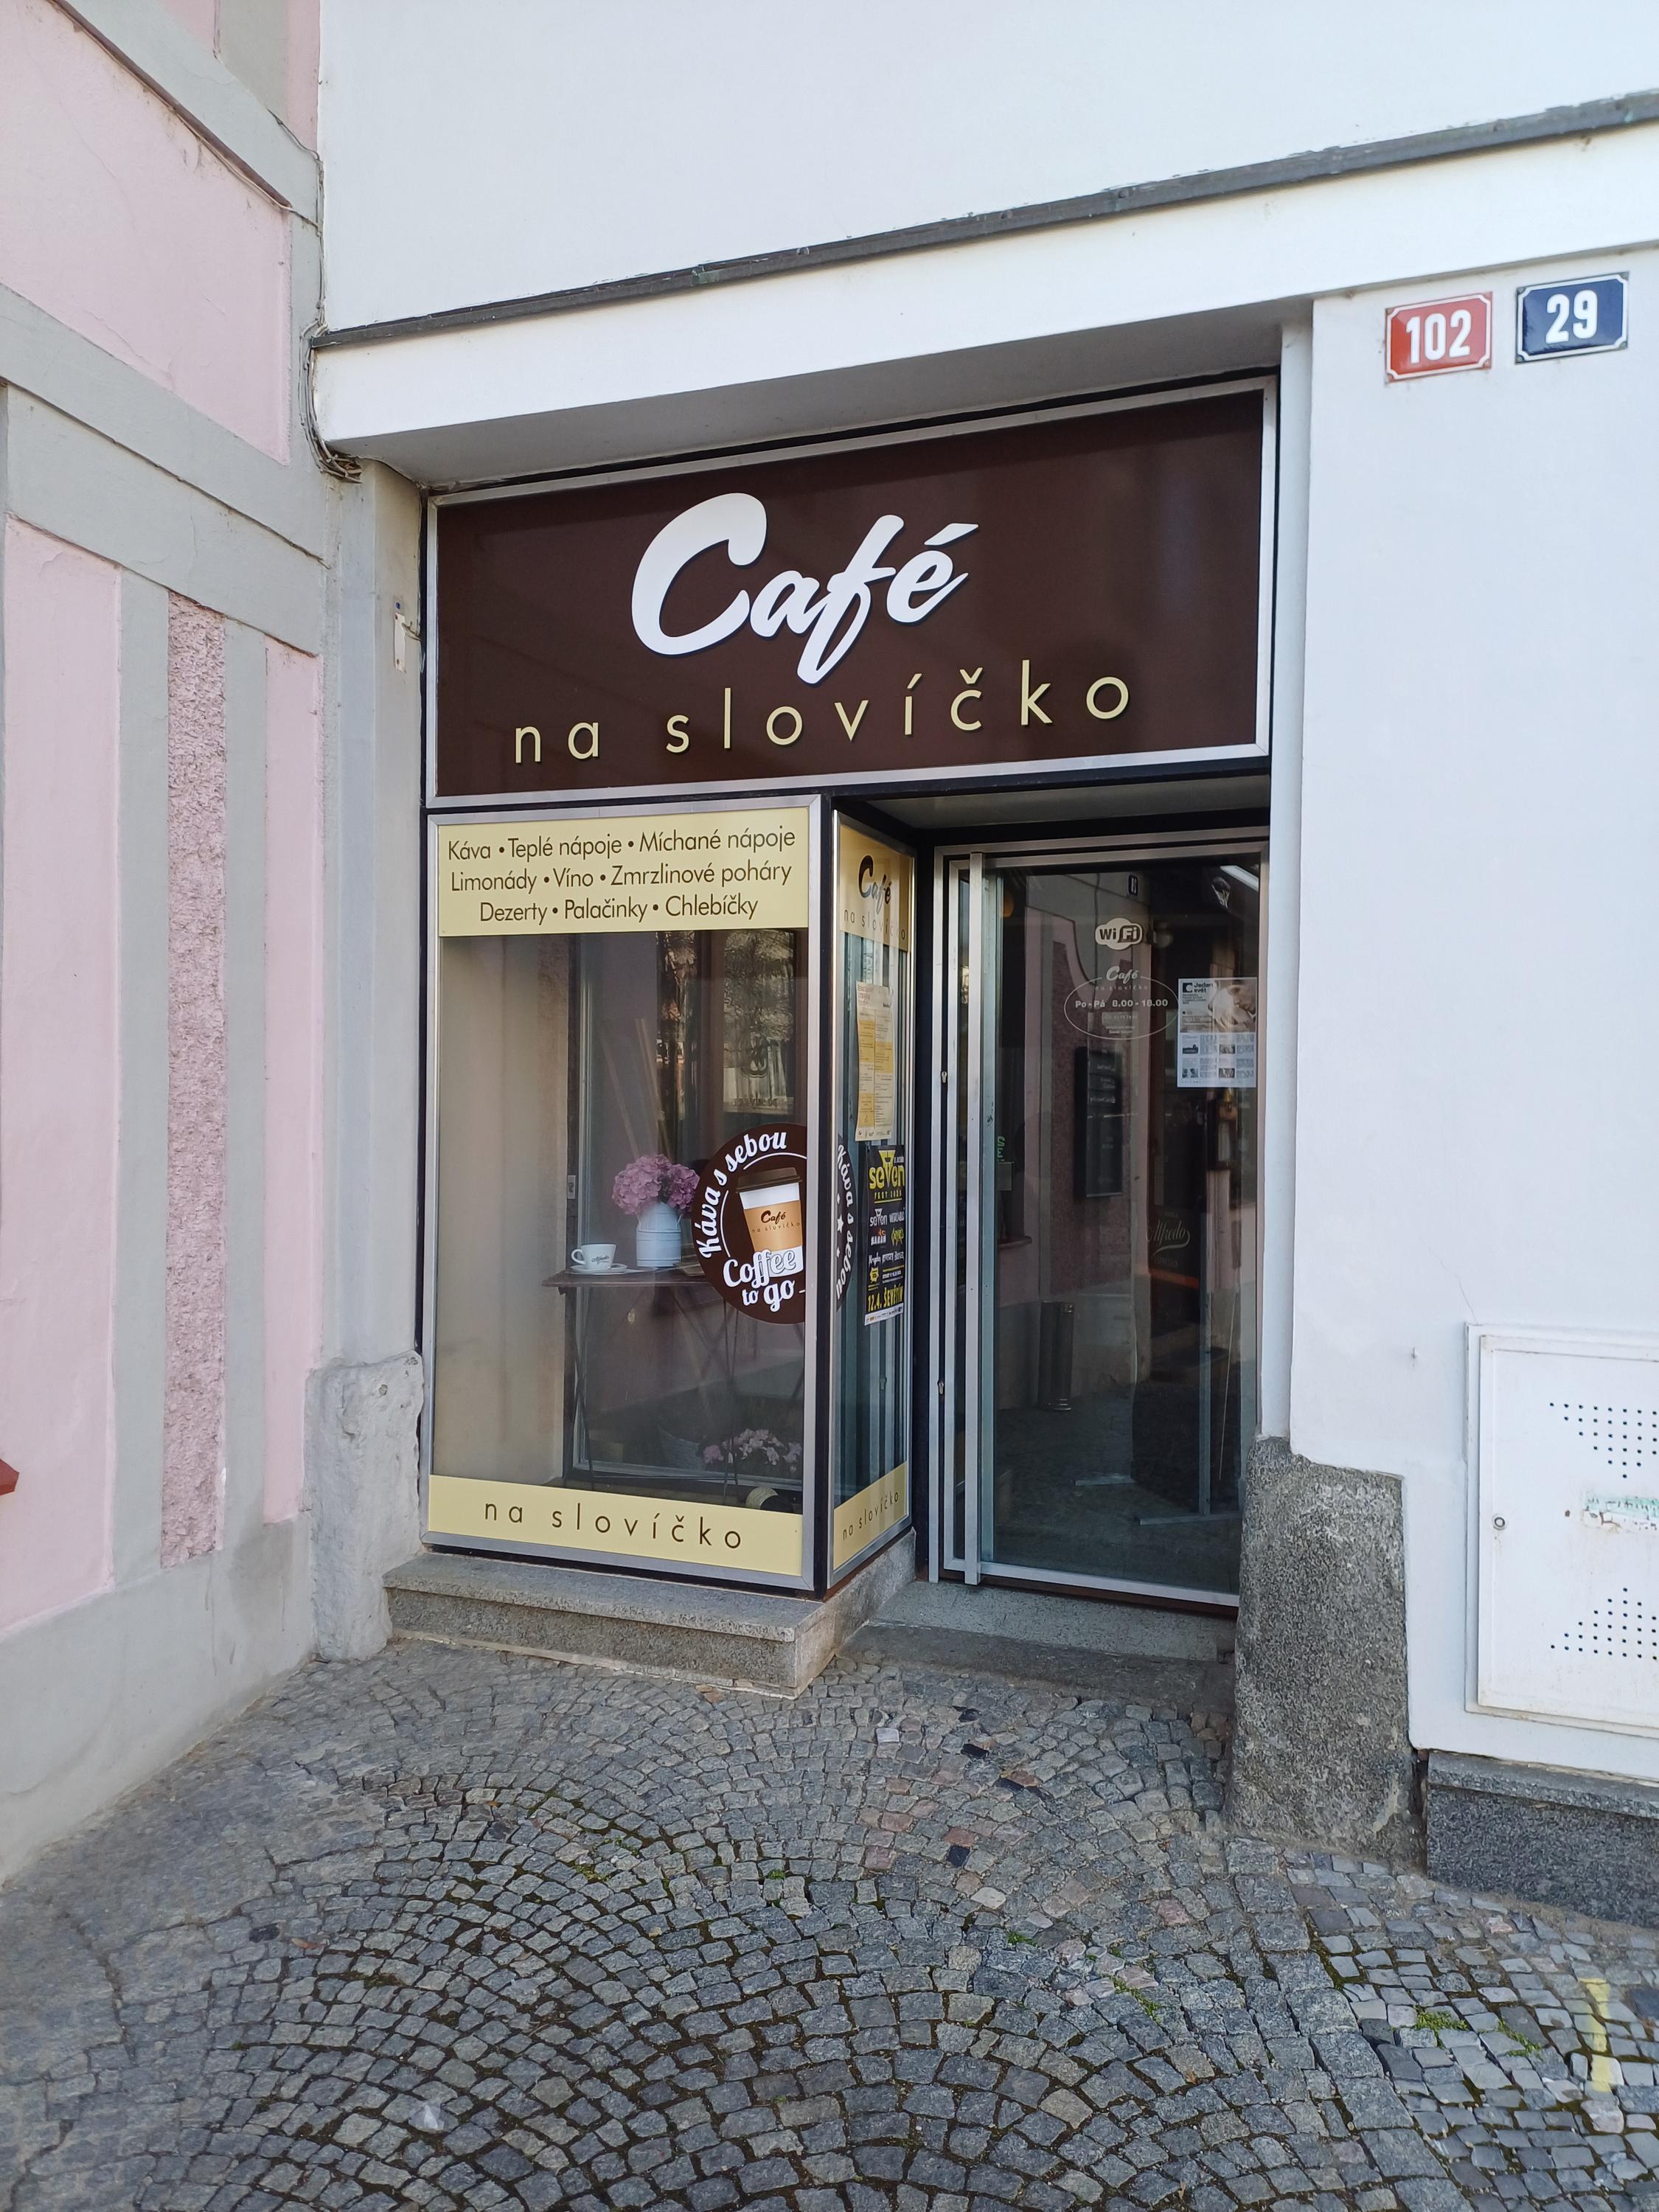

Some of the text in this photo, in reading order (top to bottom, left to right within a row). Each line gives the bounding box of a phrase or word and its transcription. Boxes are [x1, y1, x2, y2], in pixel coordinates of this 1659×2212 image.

[1545, 289, 1598, 344] 29
[1405, 309, 1472, 364] 102
[631, 493, 978, 685] Café
[515, 659, 1129, 764] na slovíčko
[448, 825, 796, 862] Káva Teplé nápoje Míchané nápoje
[451, 860, 792, 894] Limonády Víno Zmrzlinové poháry
[858, 855, 892, 915] Café
[480, 892, 759, 925] Dezerty Palačinky Chlebíčky
[1106, 965, 1139, 984] Café
[695, 1186, 723, 1259] Káva
[713, 1168, 728, 1186] s
[725, 1131, 787, 1172] sebou
[760, 1210, 787, 1225] Café
[723, 1249, 797, 1288] Coffee
[742, 1279, 796, 1312] to go
[484, 1500, 742, 1550] na slovíčko
[843, 1524, 854, 1540] na
